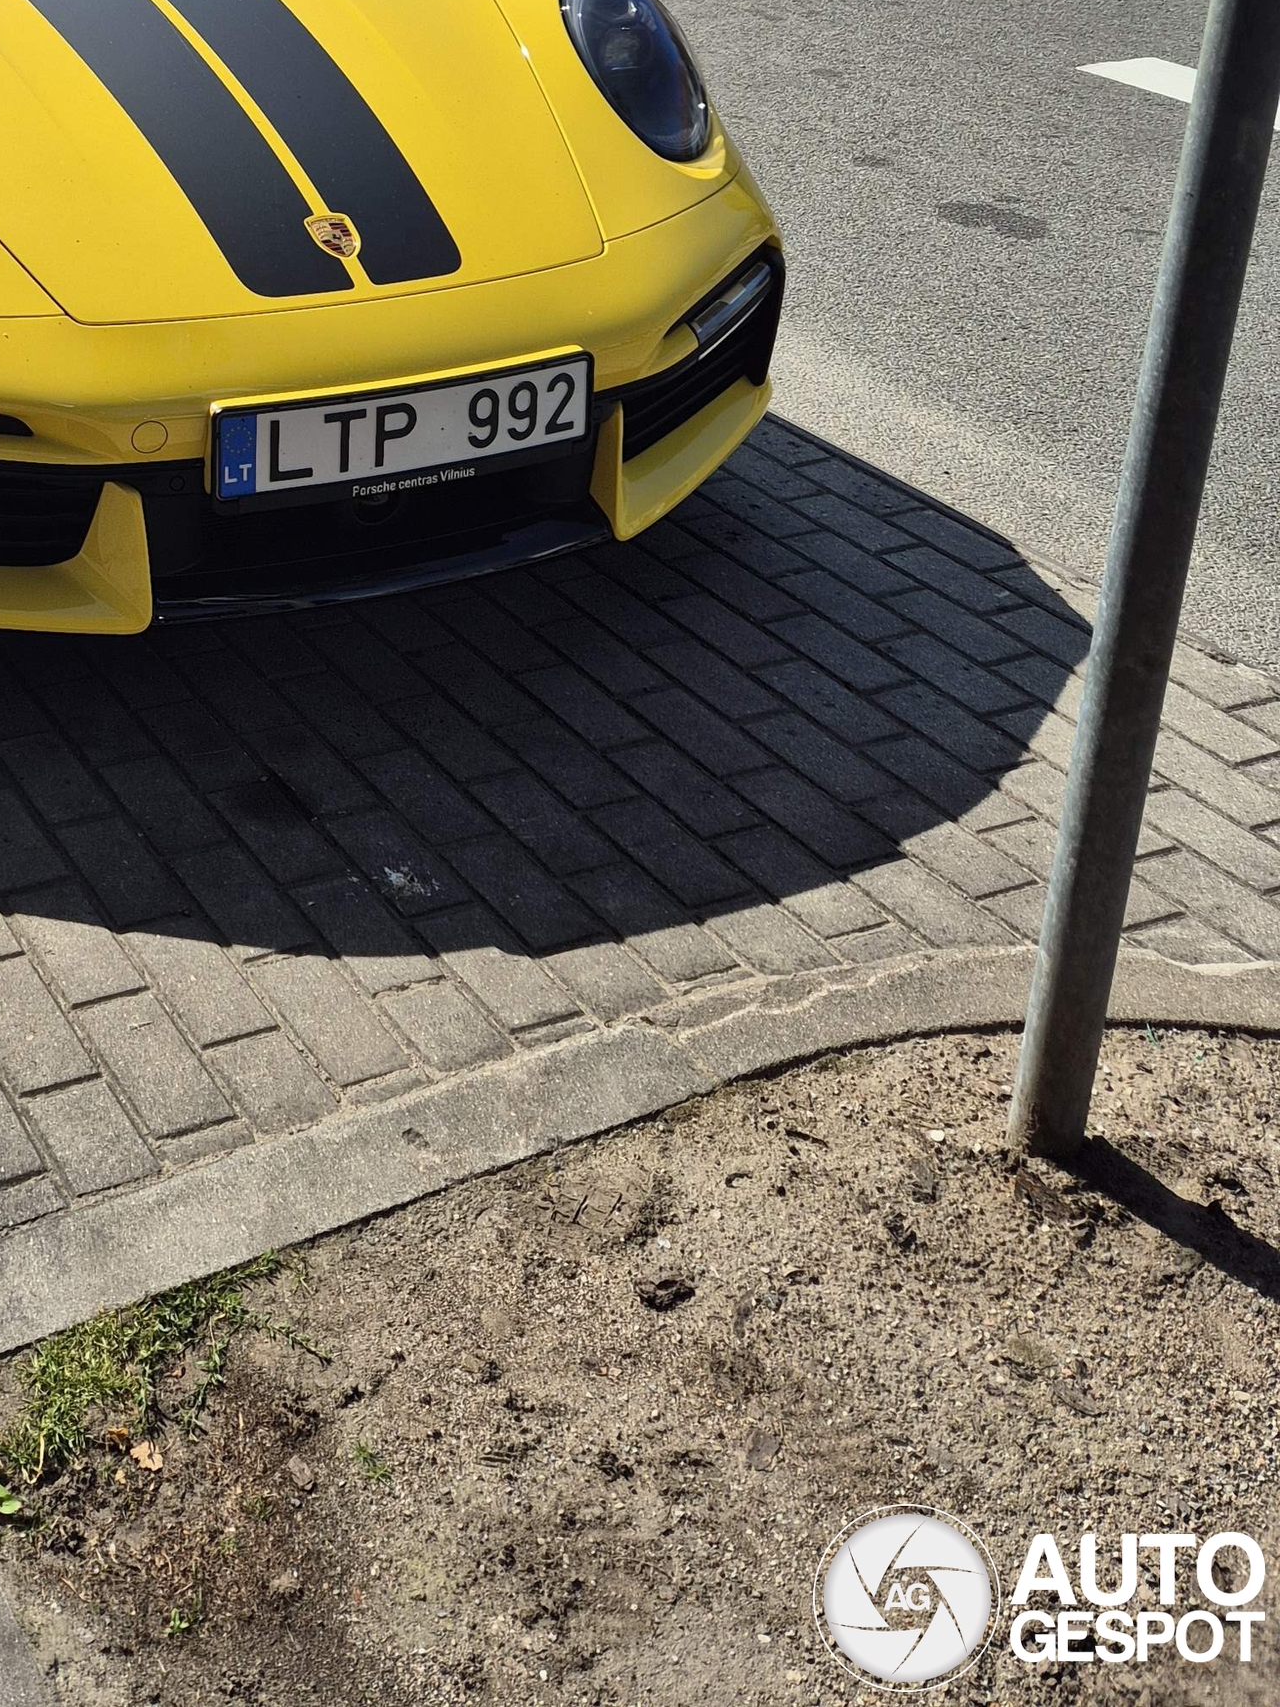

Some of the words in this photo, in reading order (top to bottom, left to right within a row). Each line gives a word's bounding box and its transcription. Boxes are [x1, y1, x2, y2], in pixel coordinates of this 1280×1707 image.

[269, 402, 418, 482] LTP
[468, 372, 575, 449] 992
[224, 463, 253, 484] LT
[352, 481, 396, 497] Porsche
[398, 474, 438, 490] centras
[440, 467, 476, 482] Vilnius
